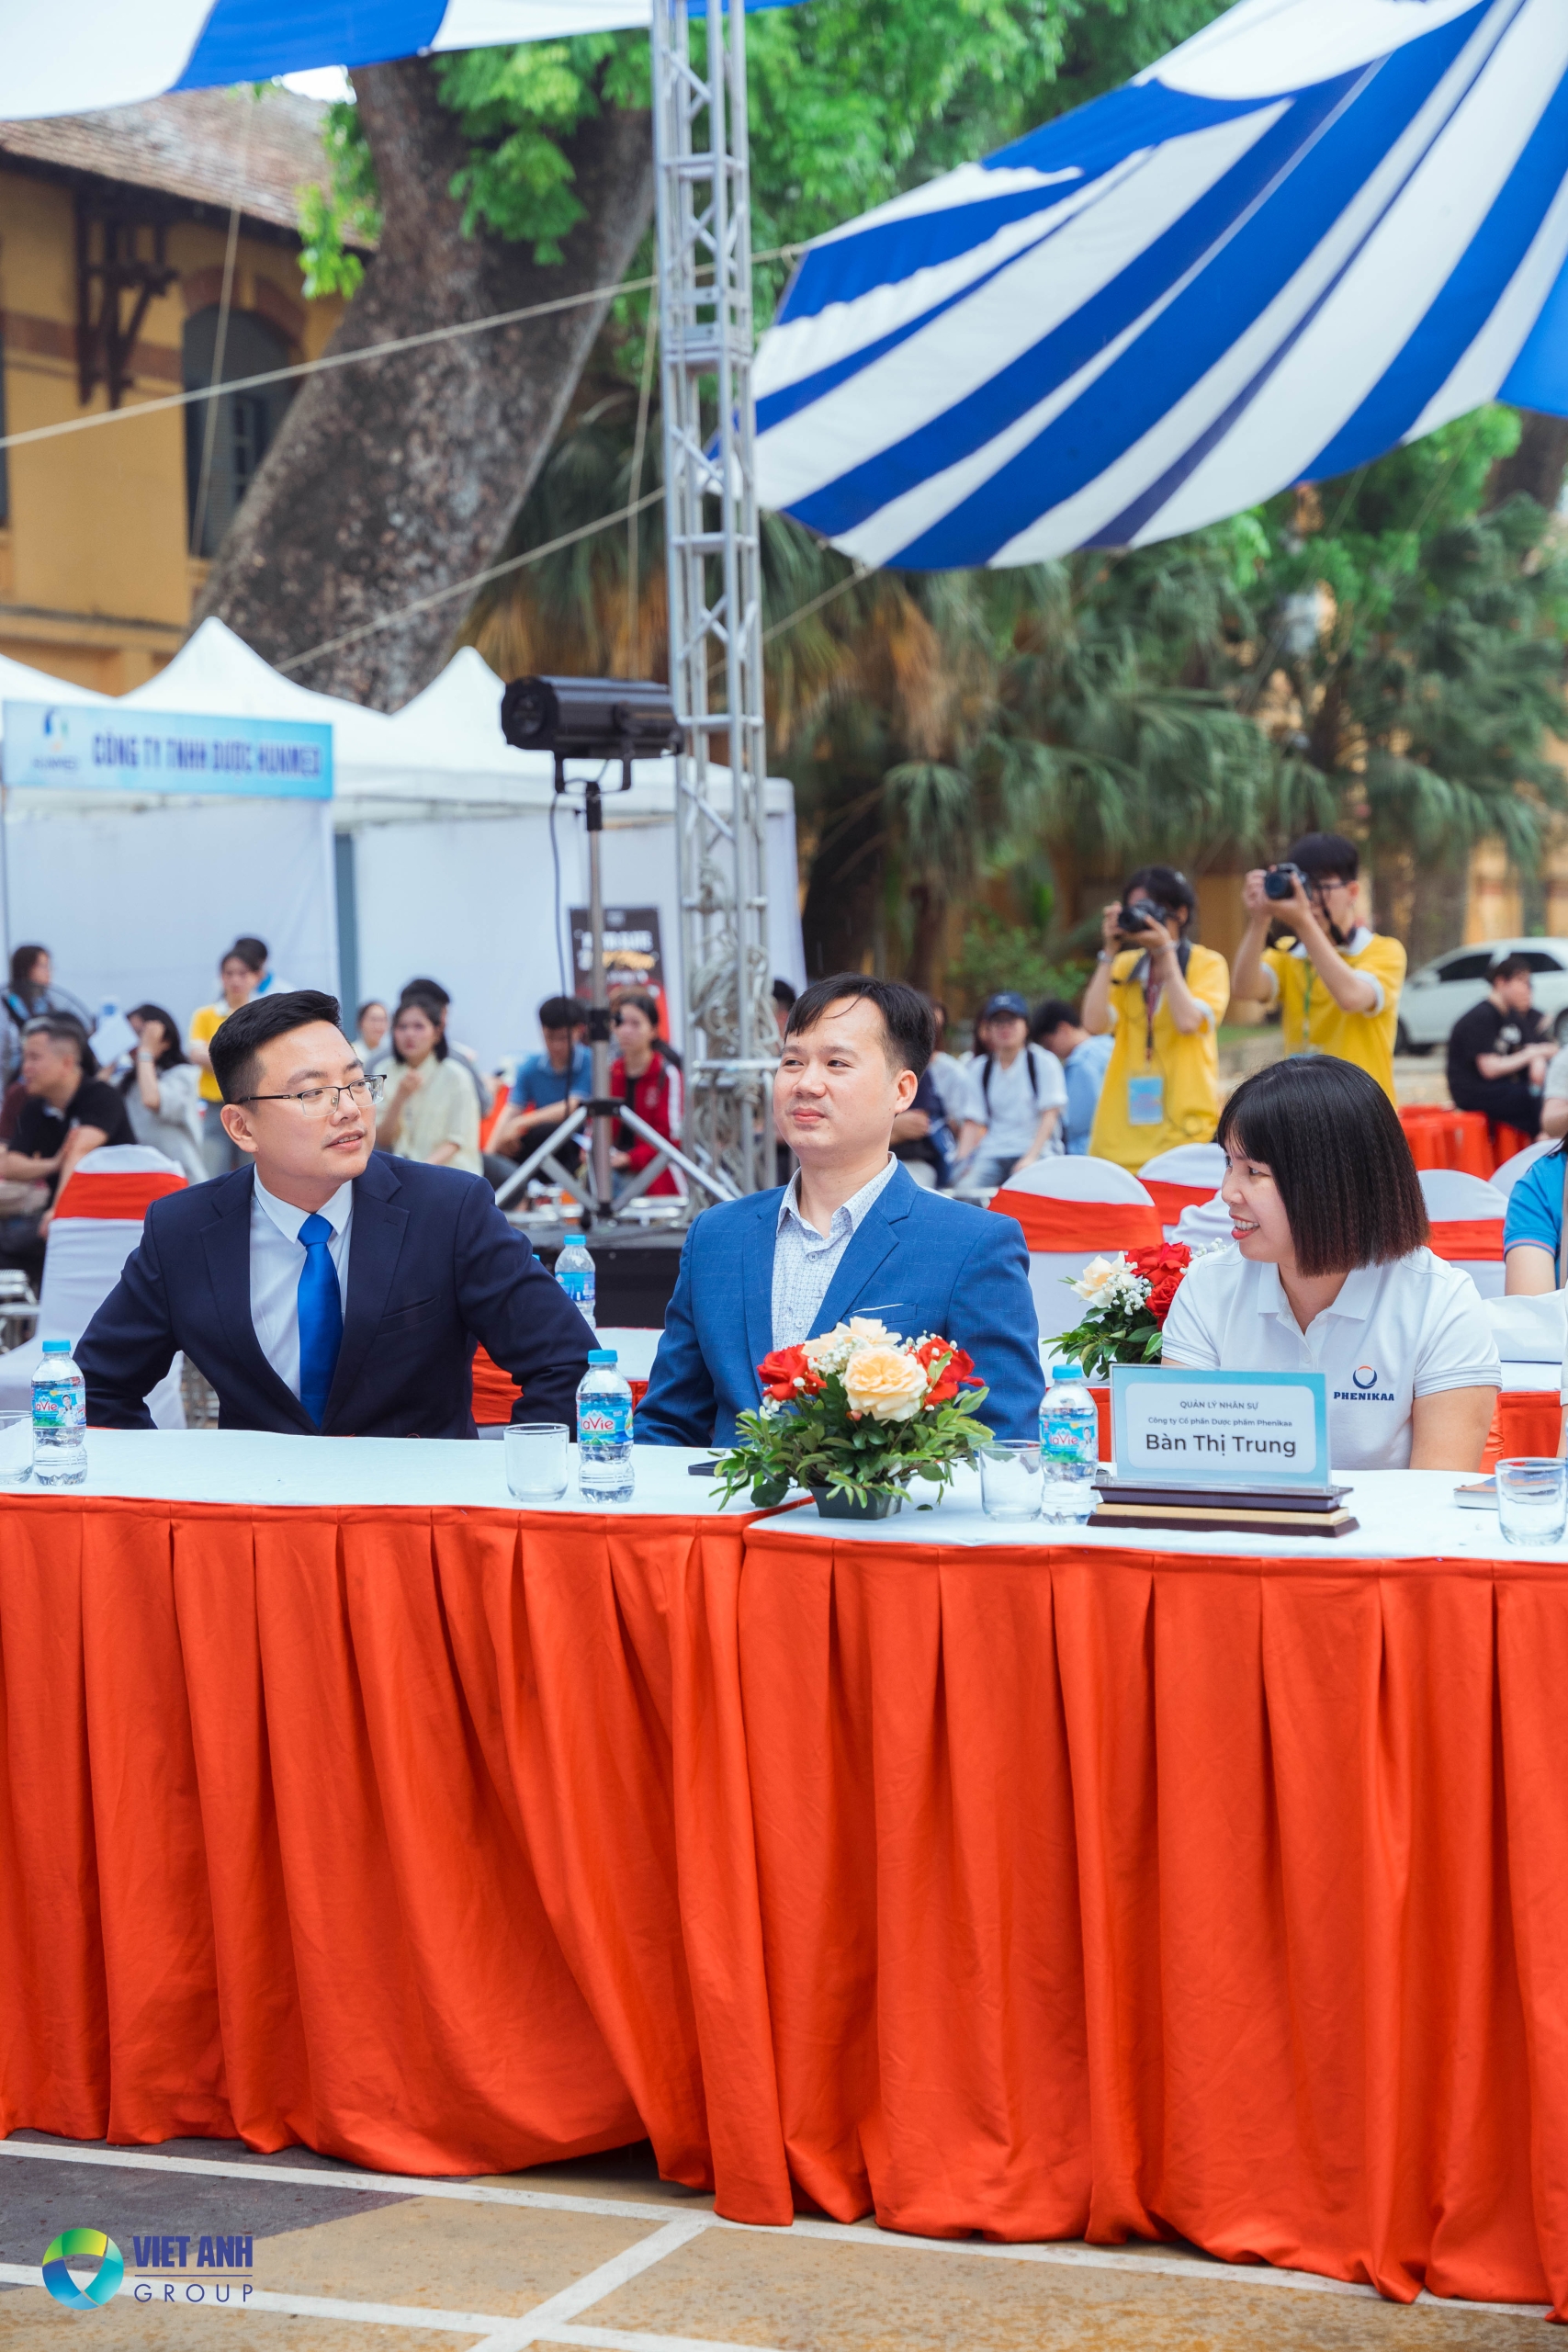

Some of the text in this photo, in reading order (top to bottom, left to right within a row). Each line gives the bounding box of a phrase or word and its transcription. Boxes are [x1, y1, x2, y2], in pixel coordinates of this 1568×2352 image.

[143, 736, 161, 767] TY
[1334, 1392, 1394, 1401] PHENIKAA
[1207, 1400, 1217, 1408] LÝ
[1219, 1400, 1245, 1409] NHÂN
[1247, 1401, 1259, 1410] SỰ
[1147, 1417, 1168, 1425] Công
[1145, 1433, 1296, 1458] Bàn Thị Trung
